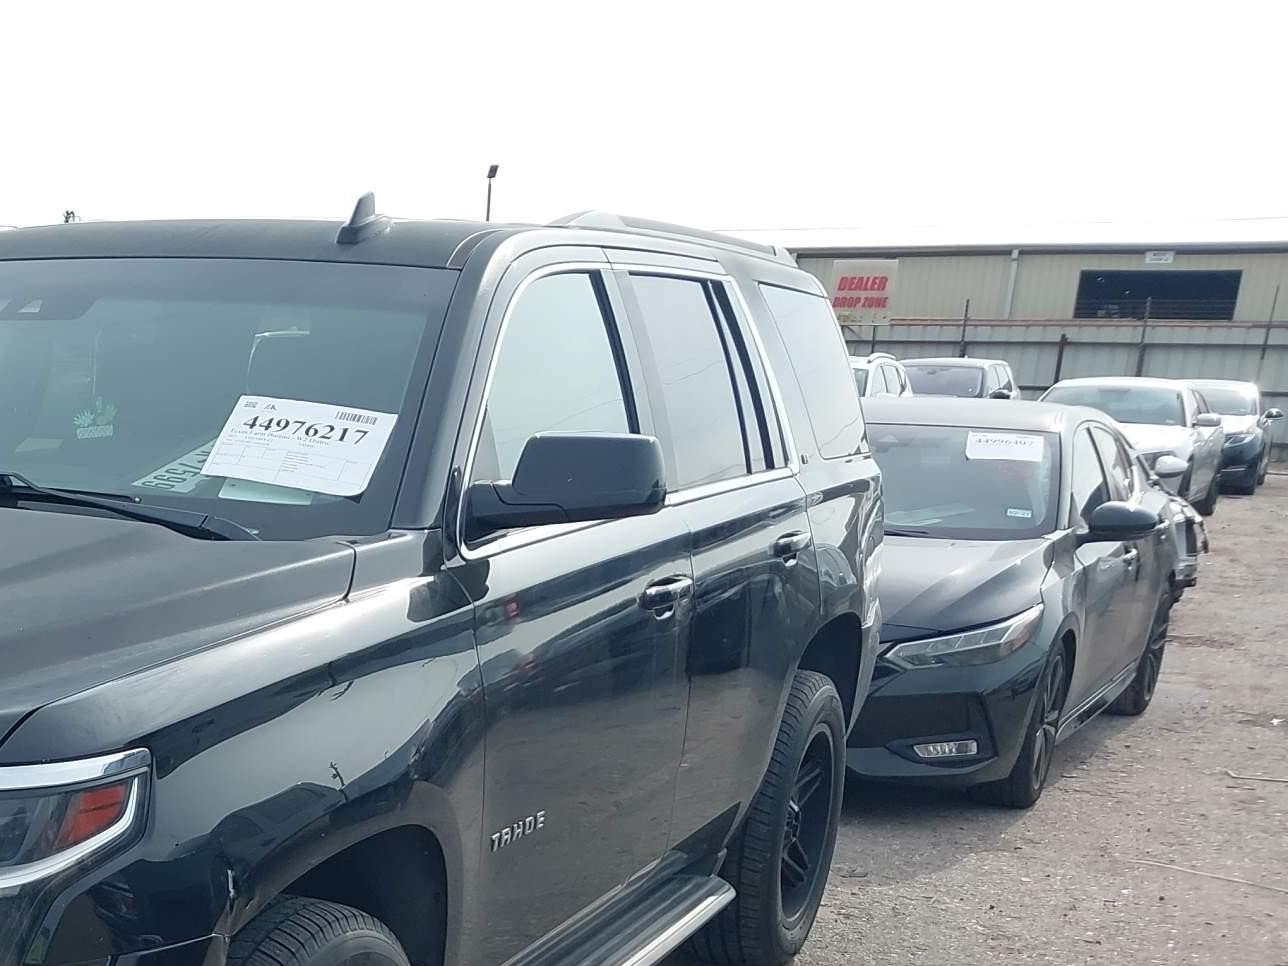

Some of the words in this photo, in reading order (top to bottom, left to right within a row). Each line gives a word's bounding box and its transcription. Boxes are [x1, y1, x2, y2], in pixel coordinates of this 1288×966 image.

[838, 276, 888, 291] DEALER
[832, 296, 861, 308] DROP
[861, 296, 888, 308] ZONE
[242, 415, 370, 446] 44976217
[491, 810, 545, 853] TAHOE
